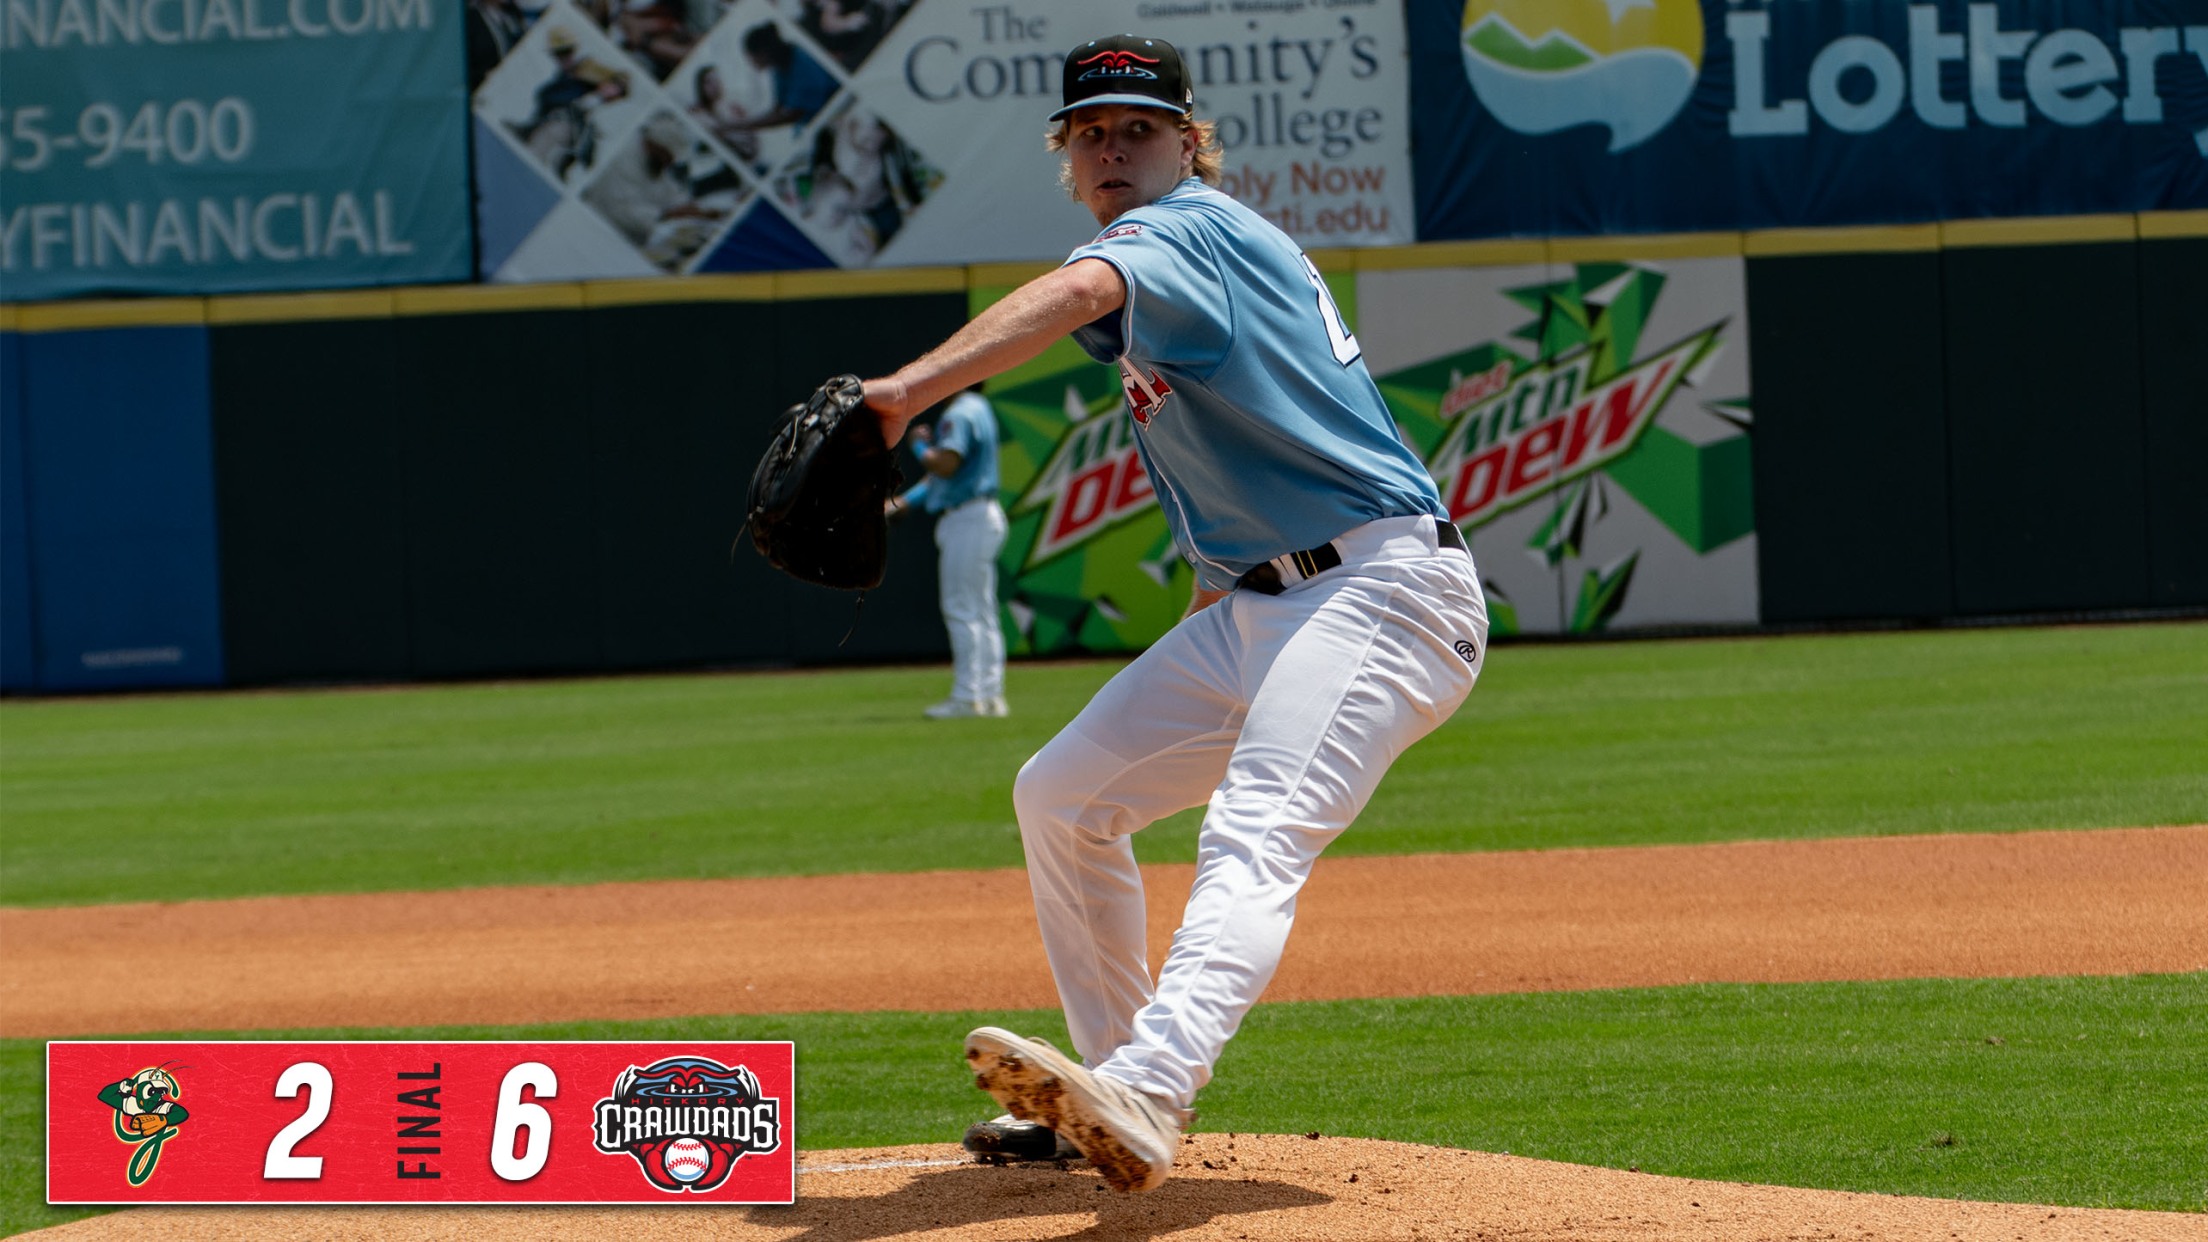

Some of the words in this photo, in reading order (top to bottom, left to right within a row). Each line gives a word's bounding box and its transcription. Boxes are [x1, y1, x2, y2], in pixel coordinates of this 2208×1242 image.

[971, 5, 1043, 43] The
[904, 15, 1380, 105] Comnity's
[0, 98, 253, 172] 5-9400
[1196, 91, 1382, 159] ollege
[1290, 160, 1385, 197] Now
[1049, 446, 1155, 546] De
